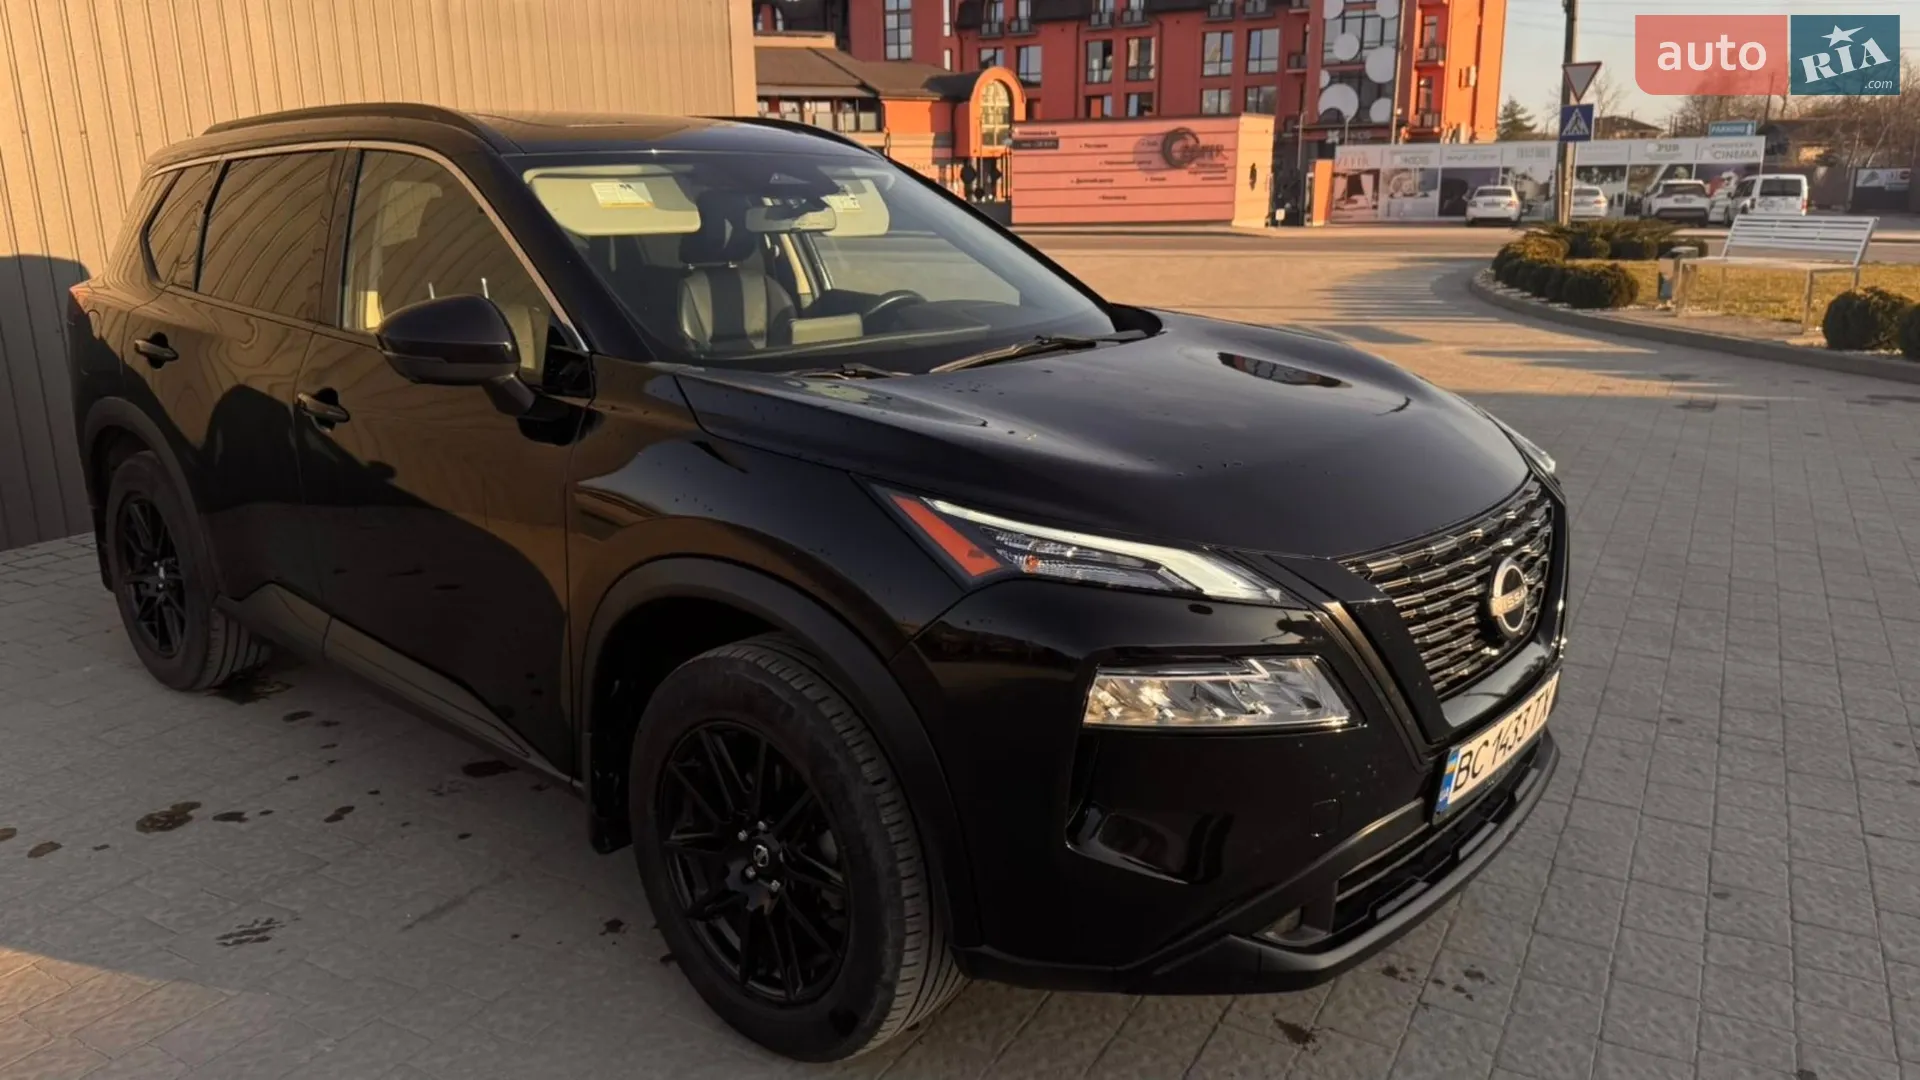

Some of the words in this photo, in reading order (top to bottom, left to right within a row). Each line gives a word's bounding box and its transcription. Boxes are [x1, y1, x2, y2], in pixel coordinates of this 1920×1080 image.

[1713, 149, 1759, 160] CINEMA
[1453, 740, 1489, 793] BC
[1492, 705, 1531, 765] 1433
[1531, 683, 1554, 731] TX
